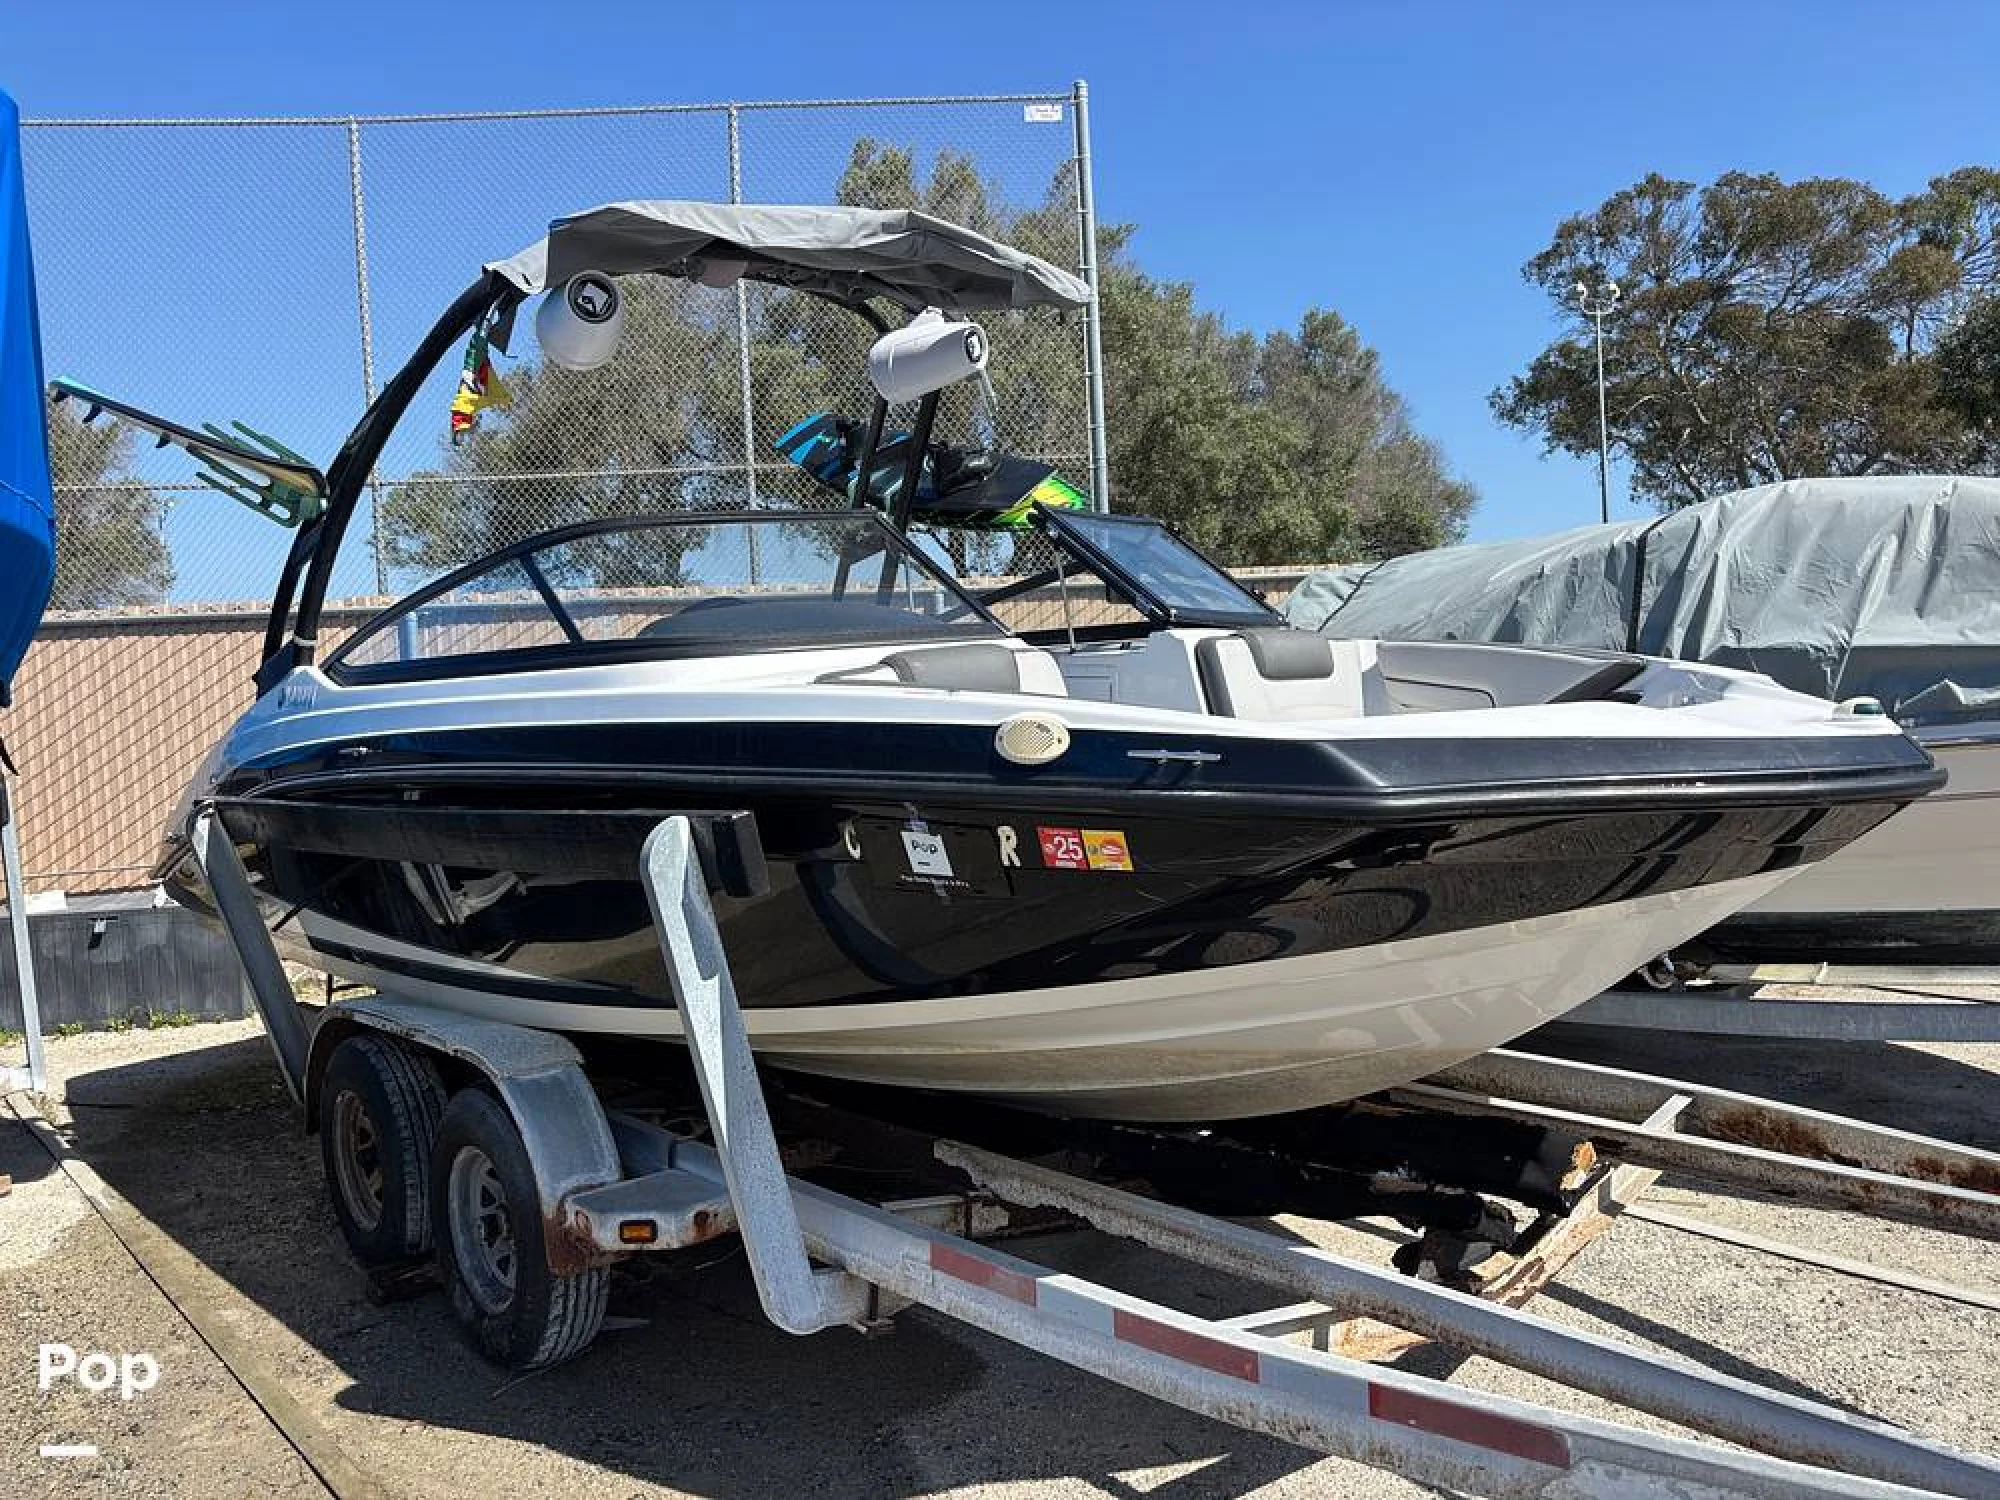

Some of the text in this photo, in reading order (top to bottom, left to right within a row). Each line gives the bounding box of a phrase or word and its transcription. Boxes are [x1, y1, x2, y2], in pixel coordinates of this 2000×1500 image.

[911, 839, 939, 855] Pop
[997, 825, 1021, 867] R
[1053, 835, 1083, 861] 25
